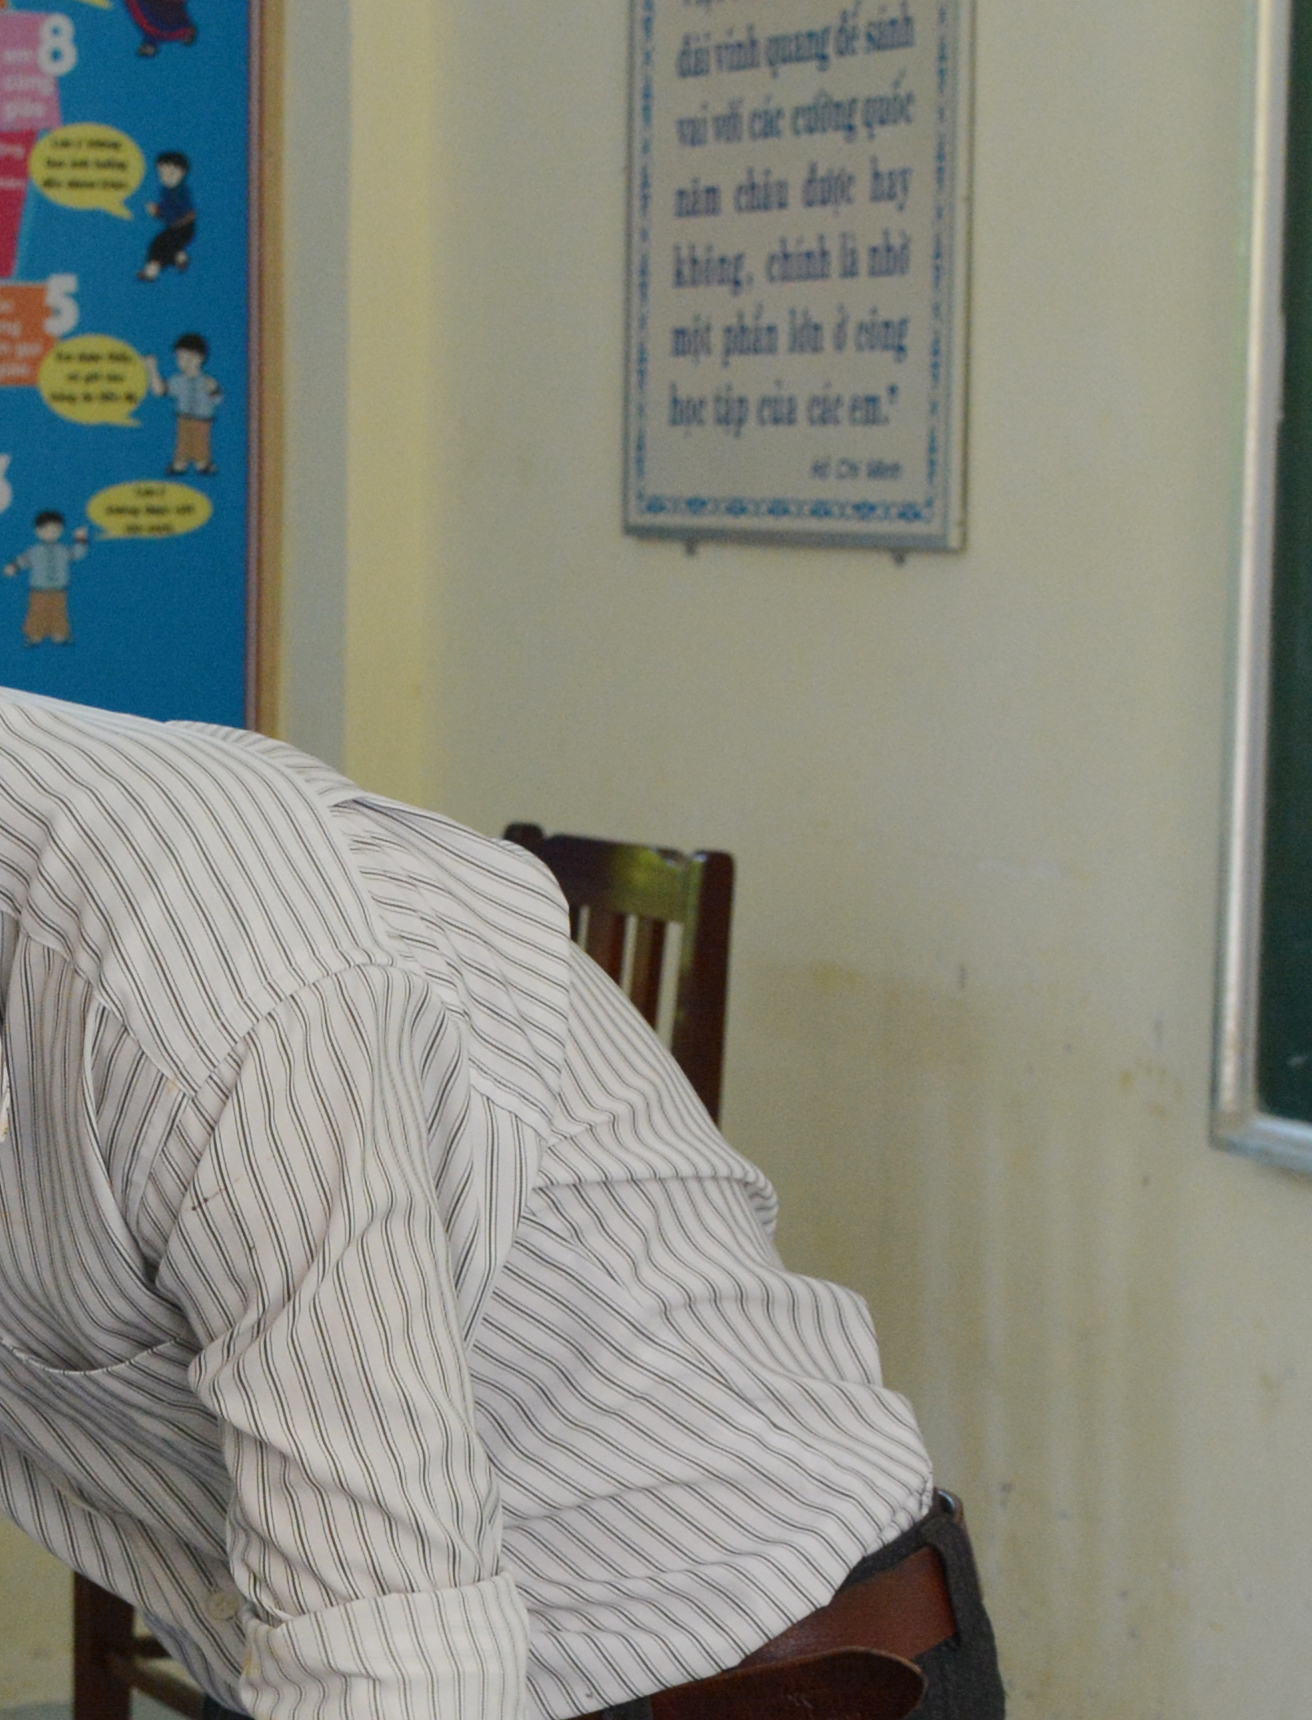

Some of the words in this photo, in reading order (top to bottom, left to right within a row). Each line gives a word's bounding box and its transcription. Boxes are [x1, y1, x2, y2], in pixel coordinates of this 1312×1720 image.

[38, 13, 77, 76] 8
[766, 25, 831, 78] quang
[749, 94, 785, 140] các
[869, 155, 912, 212] hay
[43, 276, 79, 336] 5
